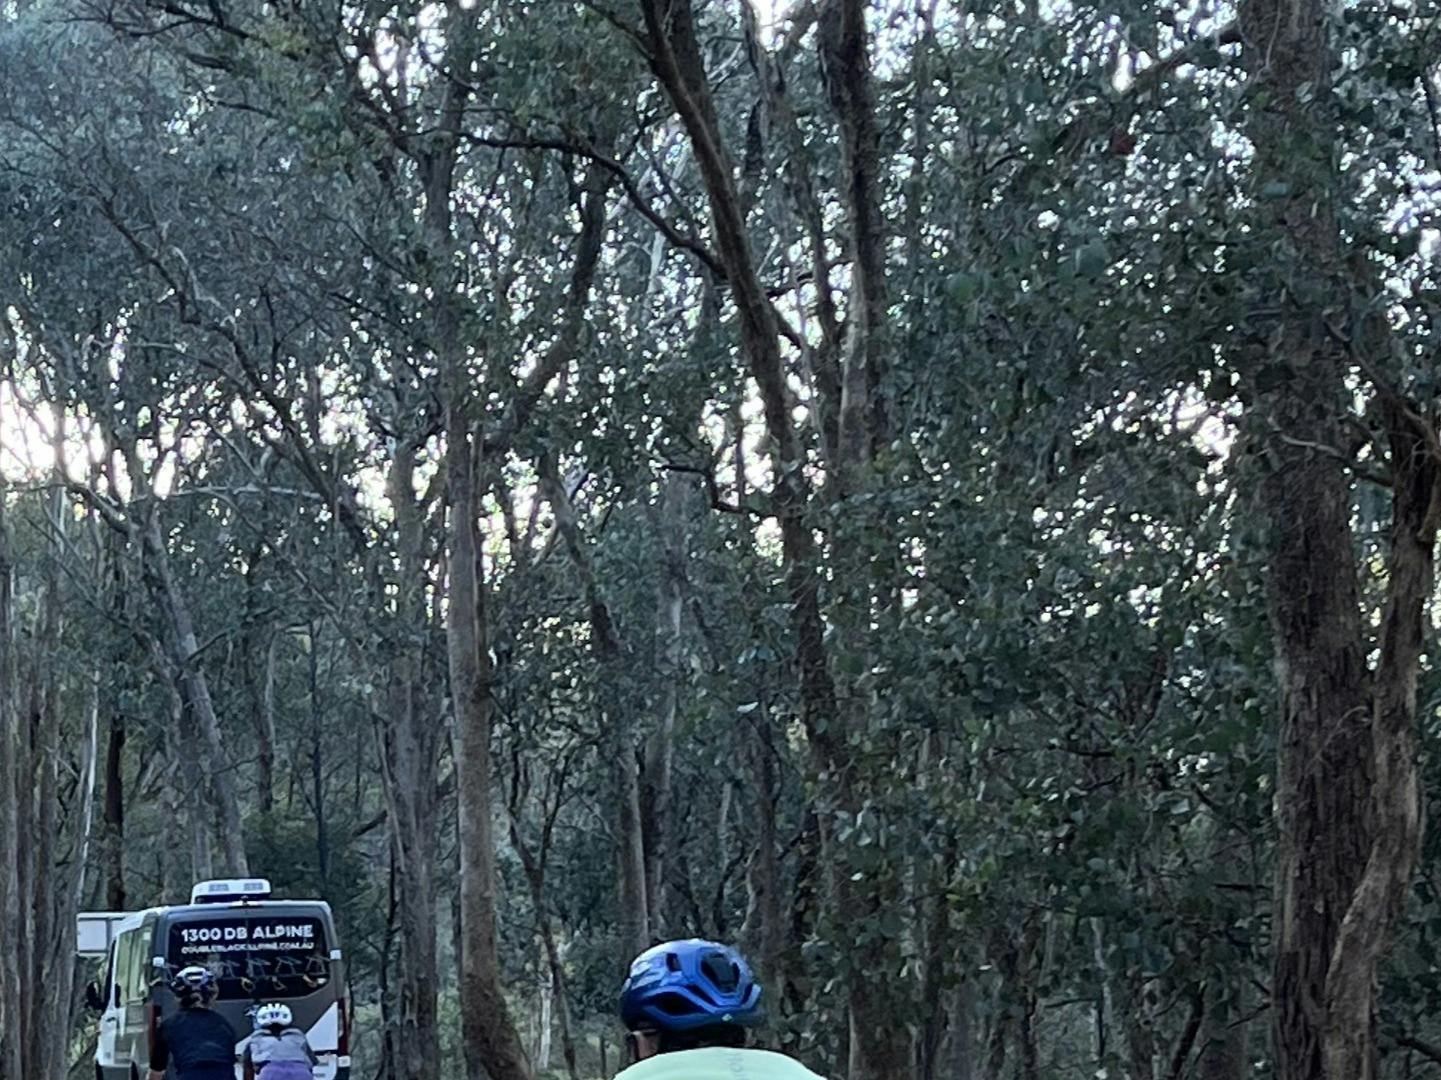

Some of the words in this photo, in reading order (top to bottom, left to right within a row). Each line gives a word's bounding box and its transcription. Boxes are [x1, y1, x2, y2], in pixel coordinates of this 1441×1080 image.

[181, 928, 222, 942] 1300
[224, 926, 248, 940] DB
[252, 924, 314, 939] ALPINE
